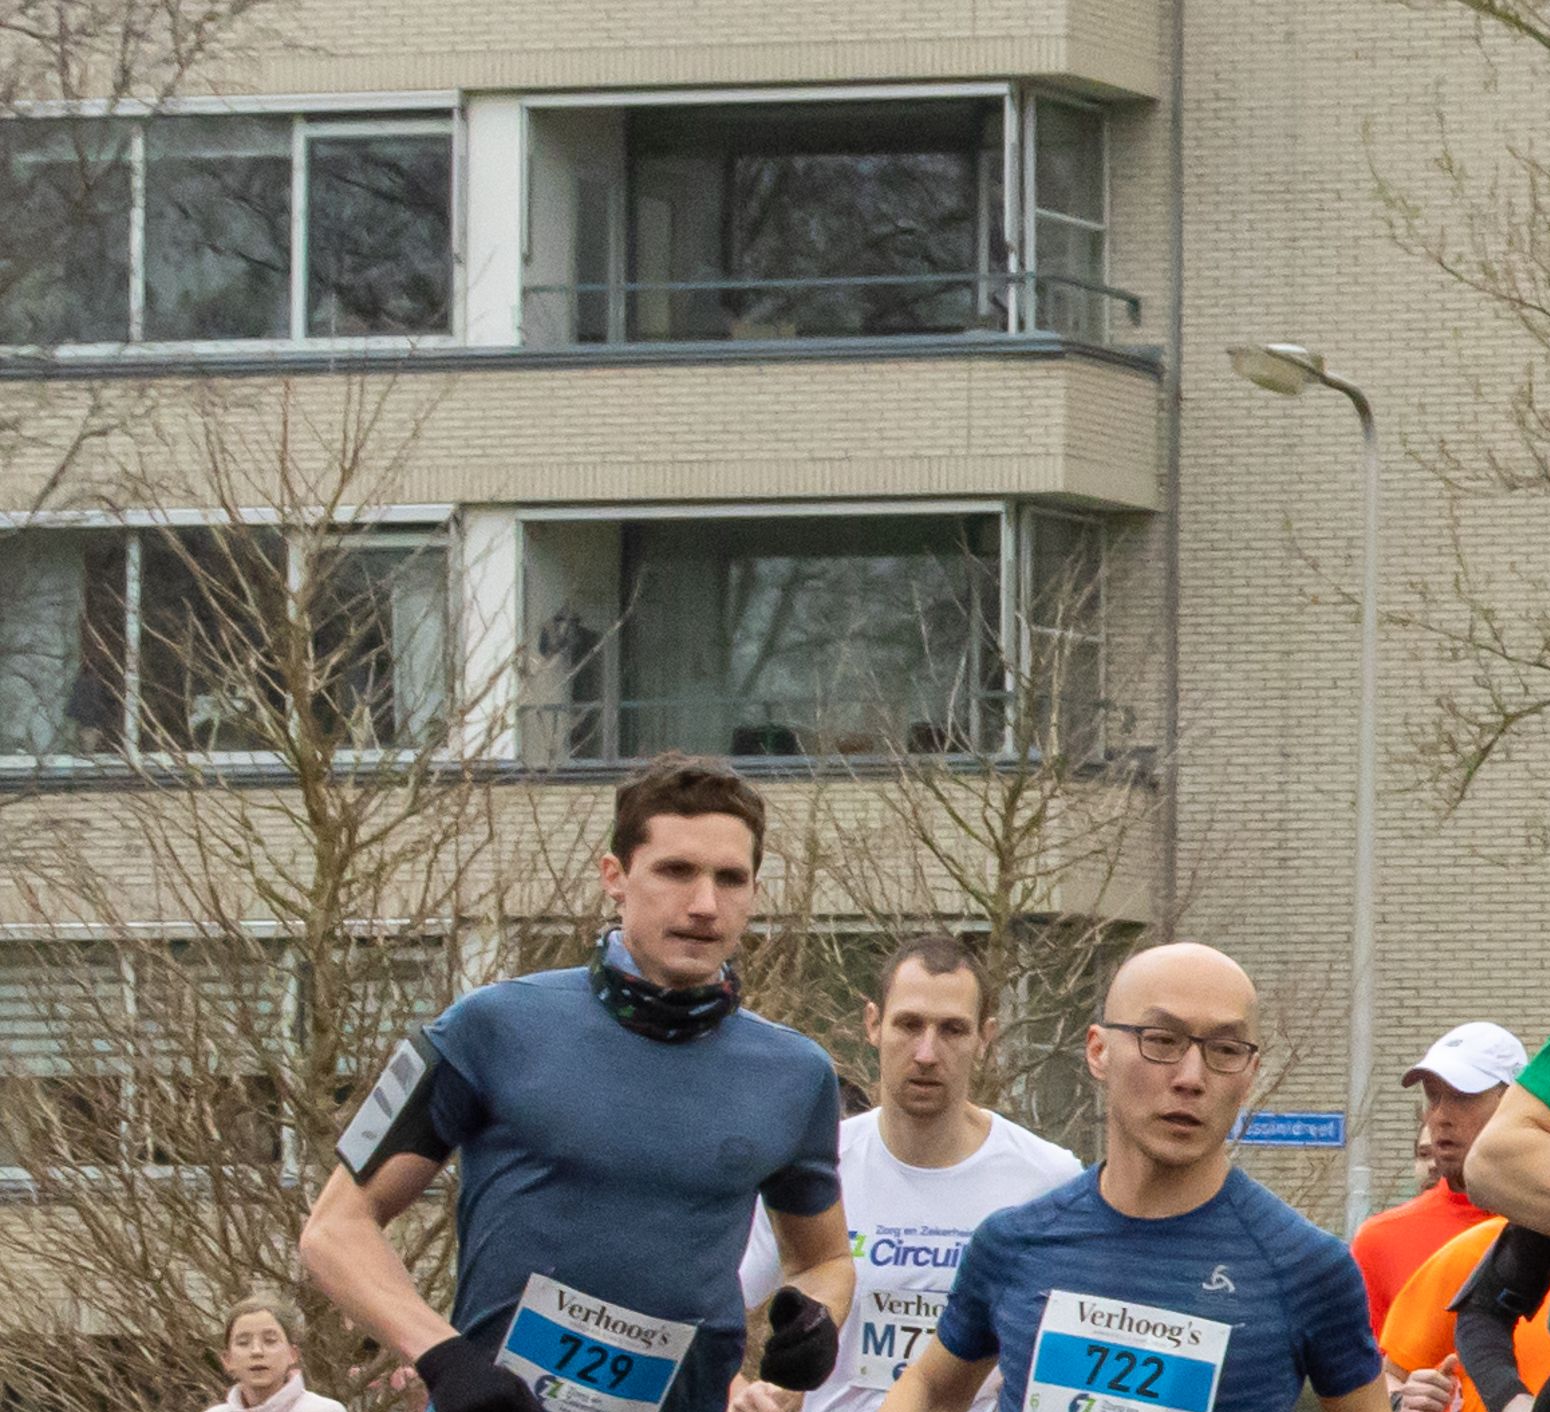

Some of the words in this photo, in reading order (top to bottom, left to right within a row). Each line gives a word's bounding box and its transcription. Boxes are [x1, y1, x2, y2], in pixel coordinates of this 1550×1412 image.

[876, 1225, 900, 1237] Zorg
[904, 1227, 917, 1235] en
[557, 1289, 672, 1348] Verhoog's
[862, 1321, 937, 1359] M7
[1077, 1301, 1202, 1349] Verhoog's
[556, 1333, 634, 1390] 729
[1087, 1343, 1166, 1399] 722
